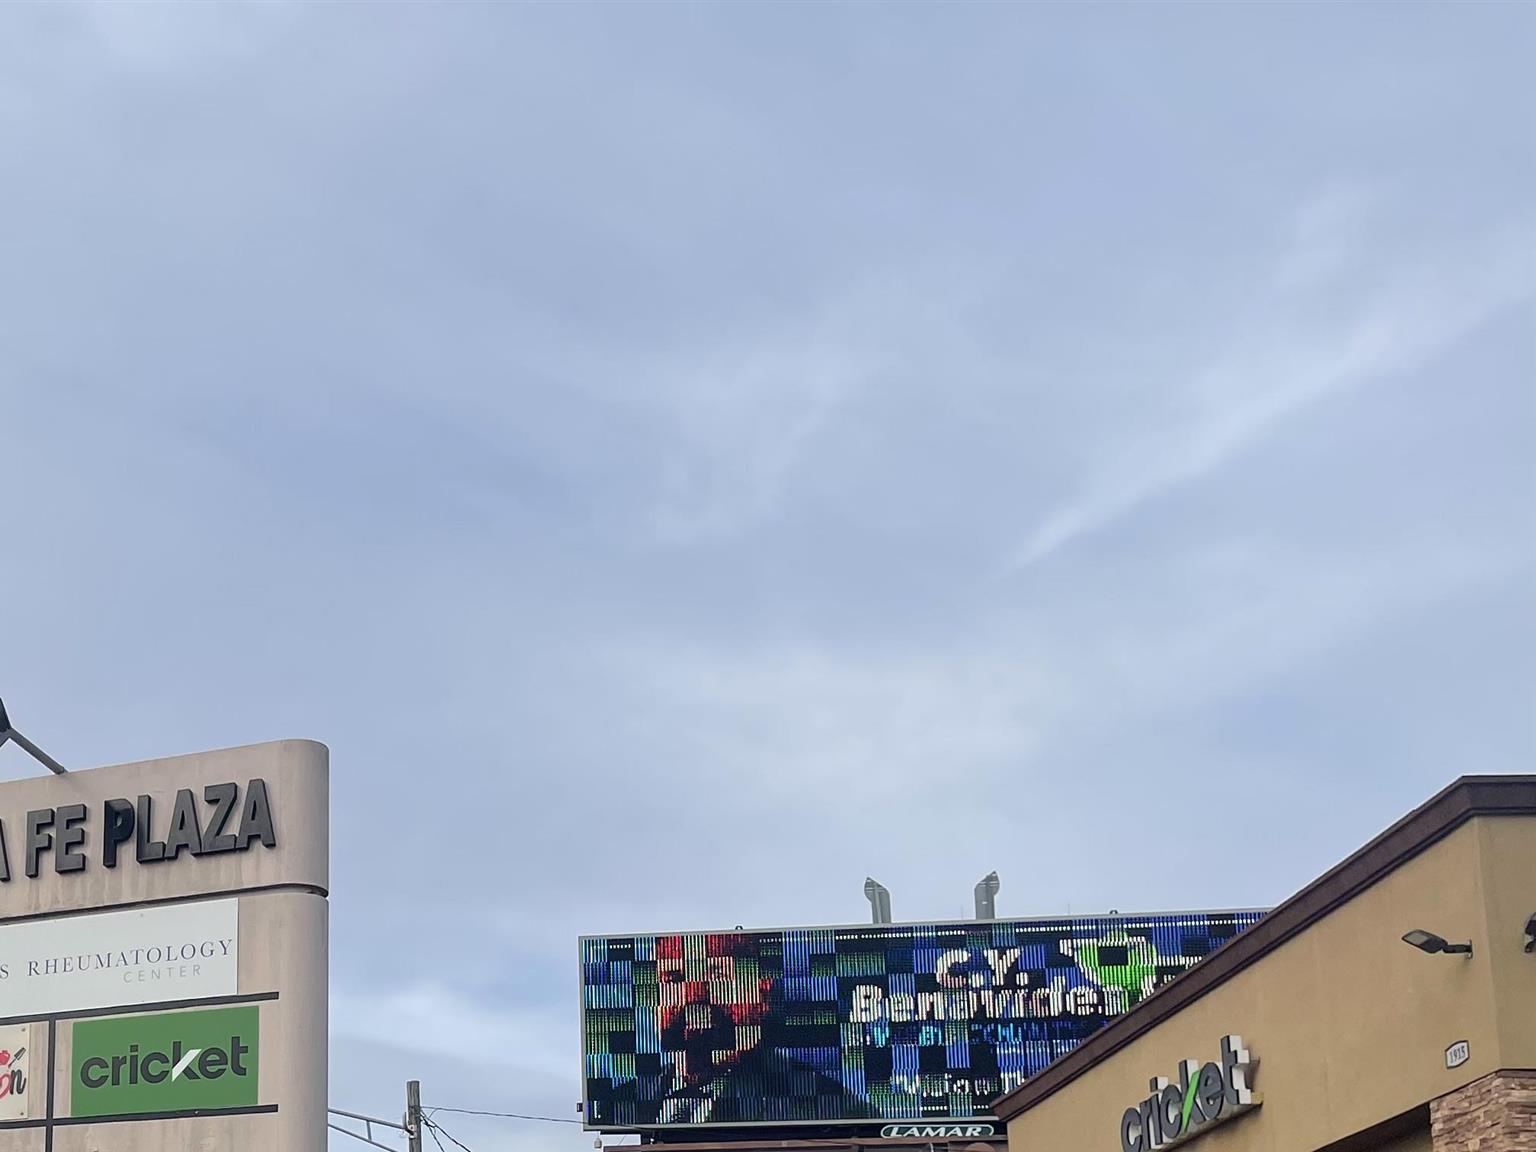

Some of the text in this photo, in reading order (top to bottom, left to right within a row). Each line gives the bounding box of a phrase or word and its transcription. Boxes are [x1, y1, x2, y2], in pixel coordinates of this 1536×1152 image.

[25, 803, 87, 878] FE
[102, 778, 276, 867] PLAZA
[27, 938, 233, 978] RHEUMATOLOGY
[123, 963, 202, 984] CENTER
[79, 1035, 249, 1089] cricket
[889, 1124, 984, 1139] LAMAR
